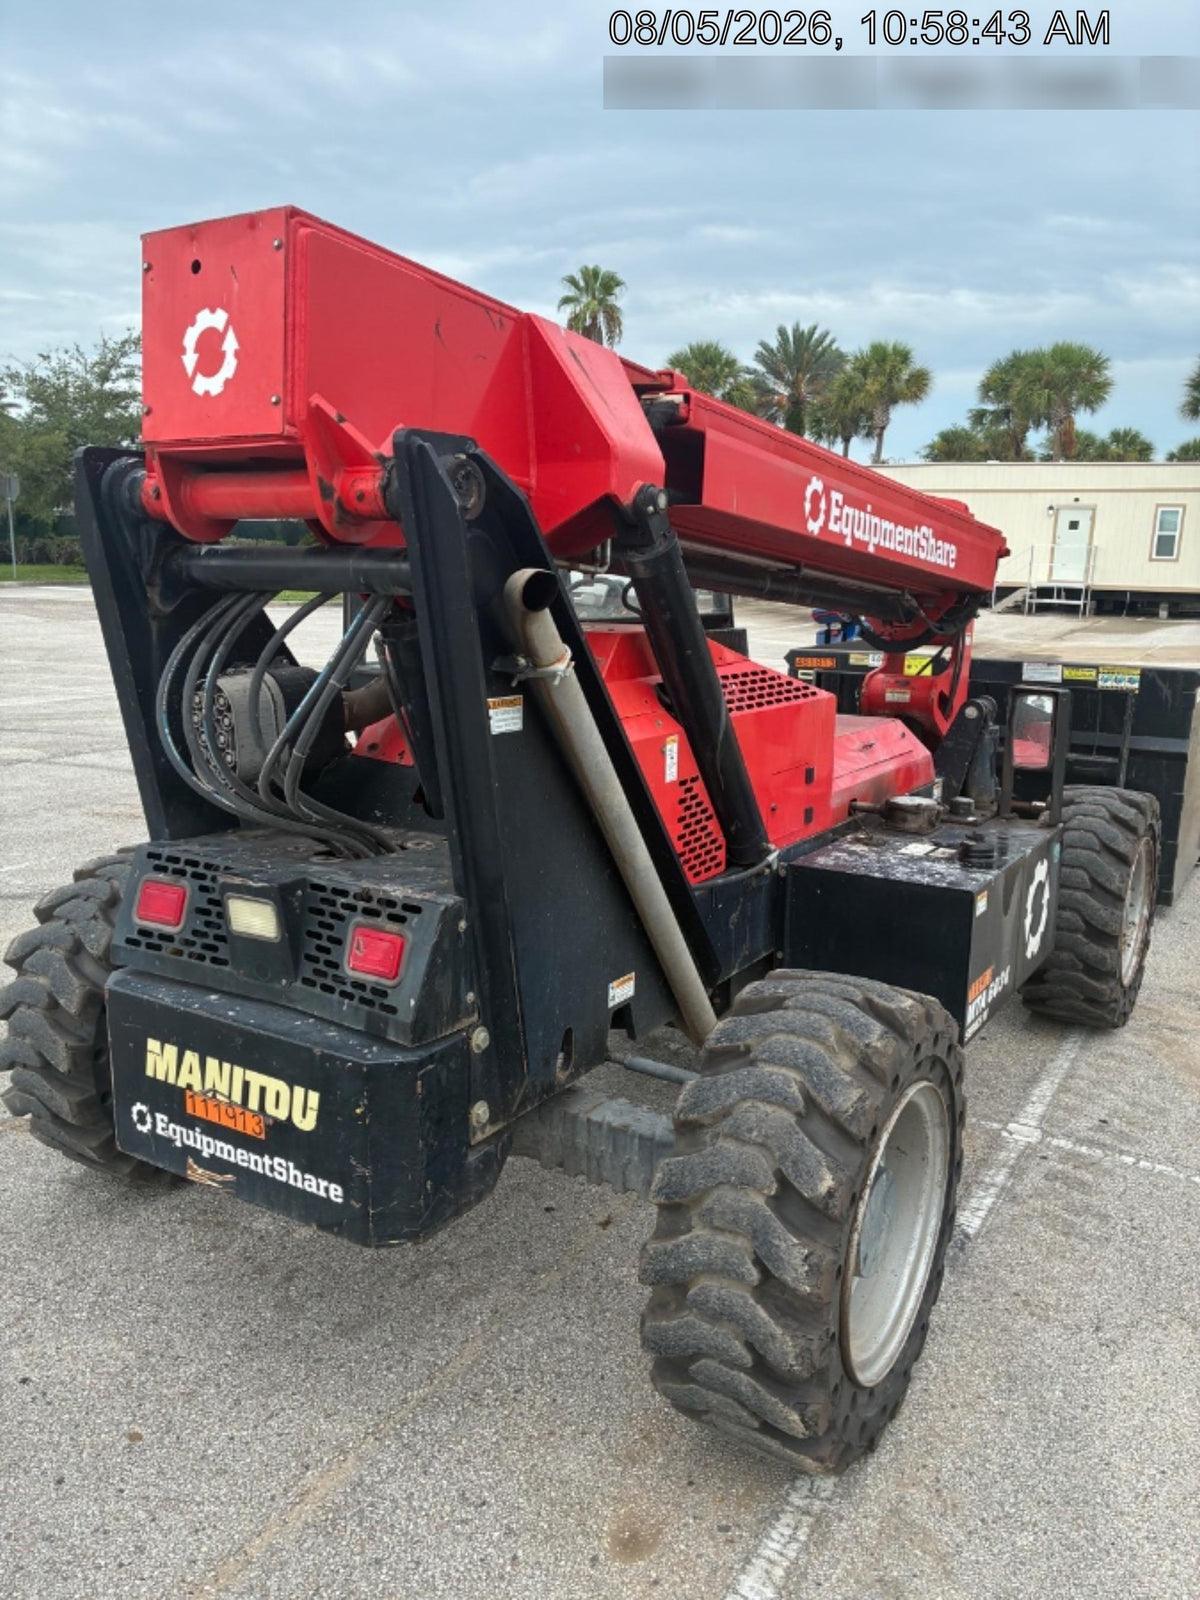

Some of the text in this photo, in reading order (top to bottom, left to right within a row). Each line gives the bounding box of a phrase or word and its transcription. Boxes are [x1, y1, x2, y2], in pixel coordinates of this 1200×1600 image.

[828, 490, 957, 569] EquipmentShare
[145, 1038, 320, 1131] MANITOU
[189, 1093, 264, 1138] 111913
[155, 1112, 344, 1203] EquipmentShare
